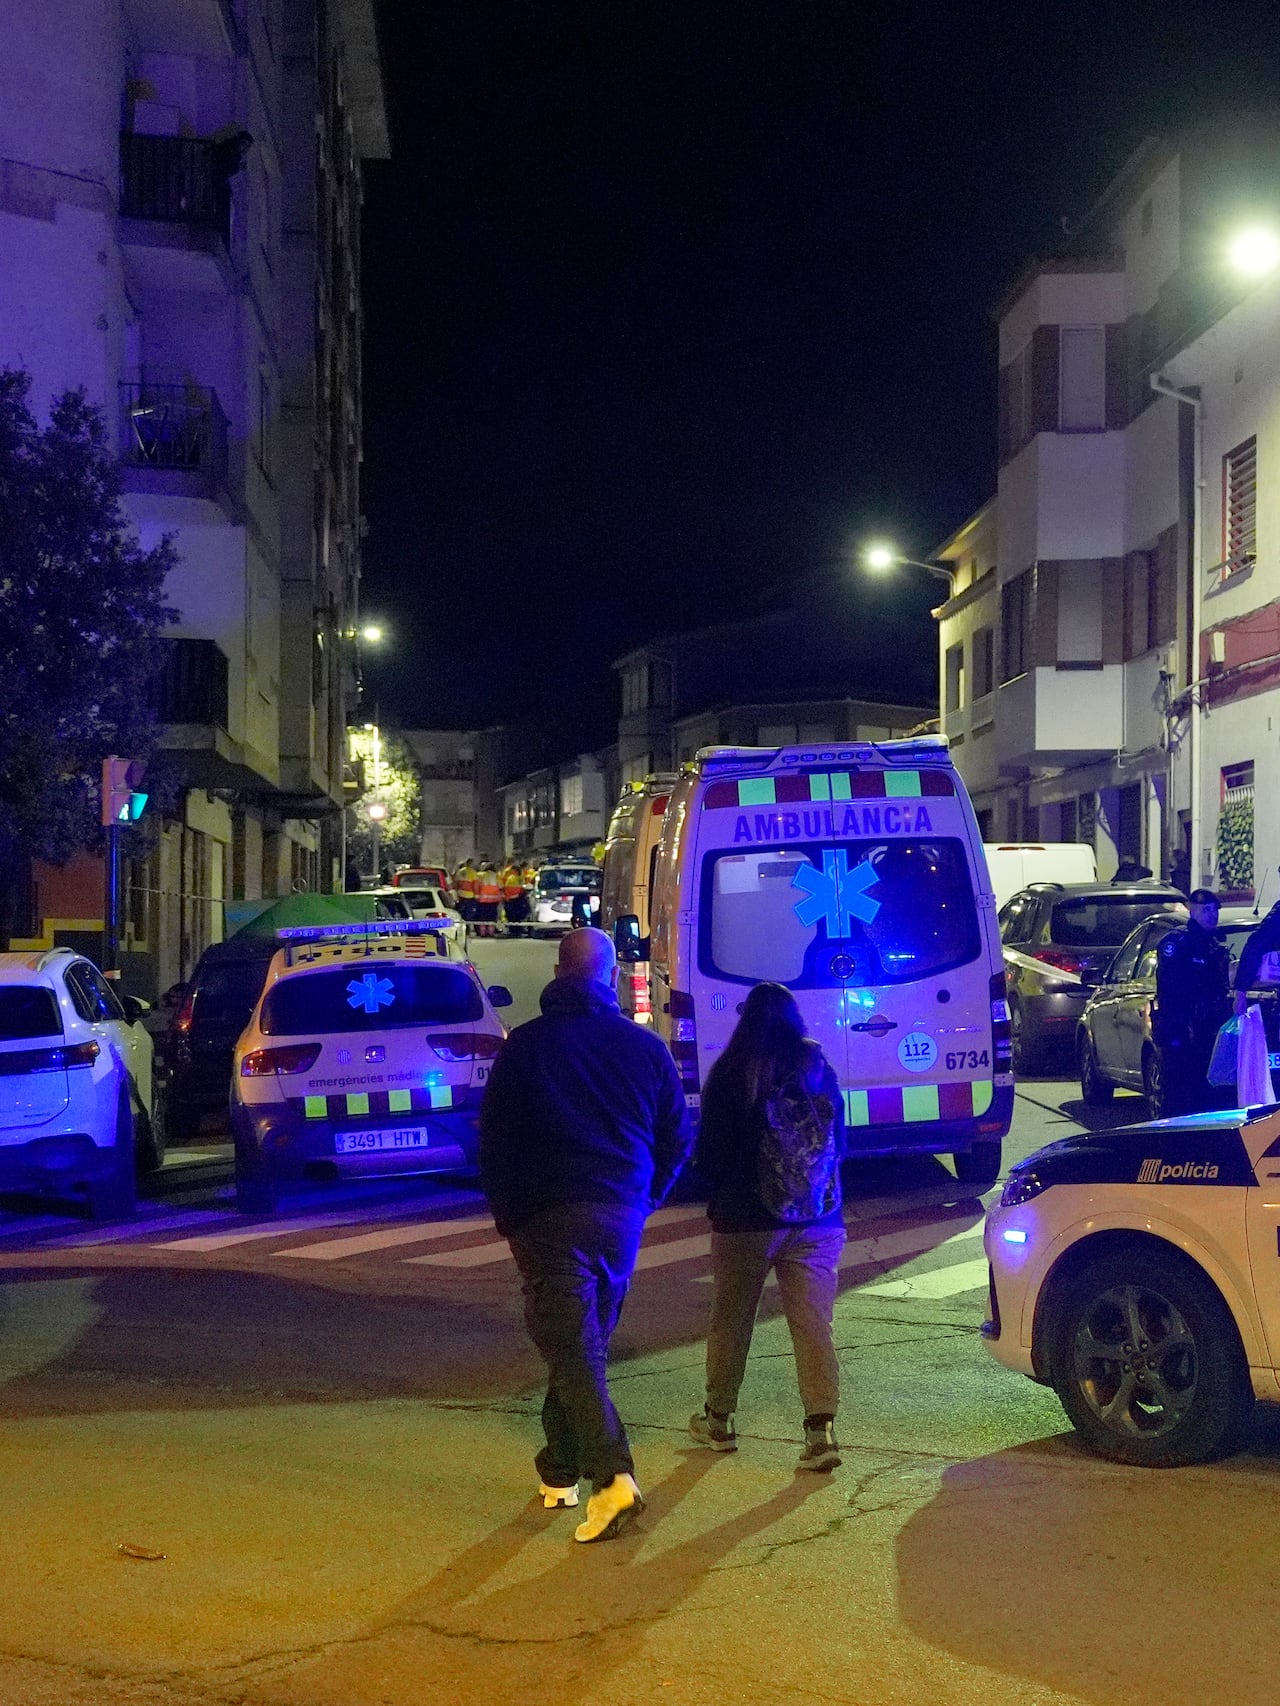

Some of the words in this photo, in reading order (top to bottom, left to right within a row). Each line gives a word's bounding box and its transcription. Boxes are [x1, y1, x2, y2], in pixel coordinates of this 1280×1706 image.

[904, 1042, 931, 1057] 112
[945, 1050, 989, 1070] 6734
[348, 1134, 383, 1149] 3491
[394, 1130, 421, 1146] HTW
[1158, 1161, 1220, 1181] policia
